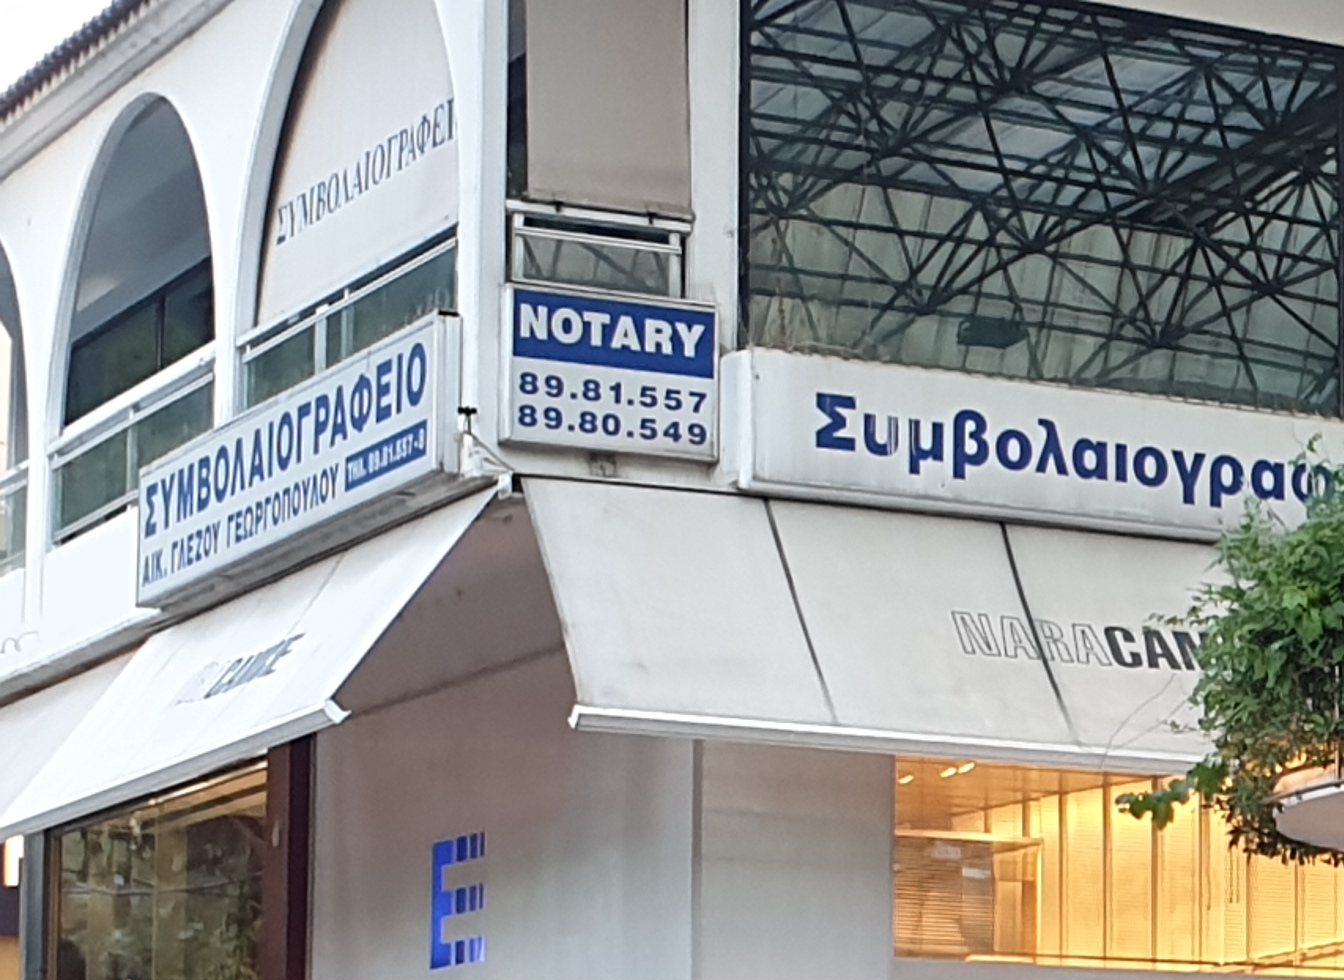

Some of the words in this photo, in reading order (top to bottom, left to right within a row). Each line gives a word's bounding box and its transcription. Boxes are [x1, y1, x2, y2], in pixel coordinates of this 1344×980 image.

[276, 97, 456, 245] ΣΥΜΒΟΛΑΙΟΓΡΑΦΕΙ
[519, 303, 706, 358] NOTARY
[517, 404, 707, 446] 89.80.549
[519, 372, 707, 414] 89.81.557
[144, 342, 427, 539] ΣΥΜΒΟΛΑΙΟΓΡΑΦΕΙΟ
[142, 549, 167, 587] ΑΙΚ.
[171, 520, 221, 575] ΓΛΕΖΟΥ
[226, 463, 339, 549] ΓΕΩΡΓΟΠΟΥΛΟΥ
